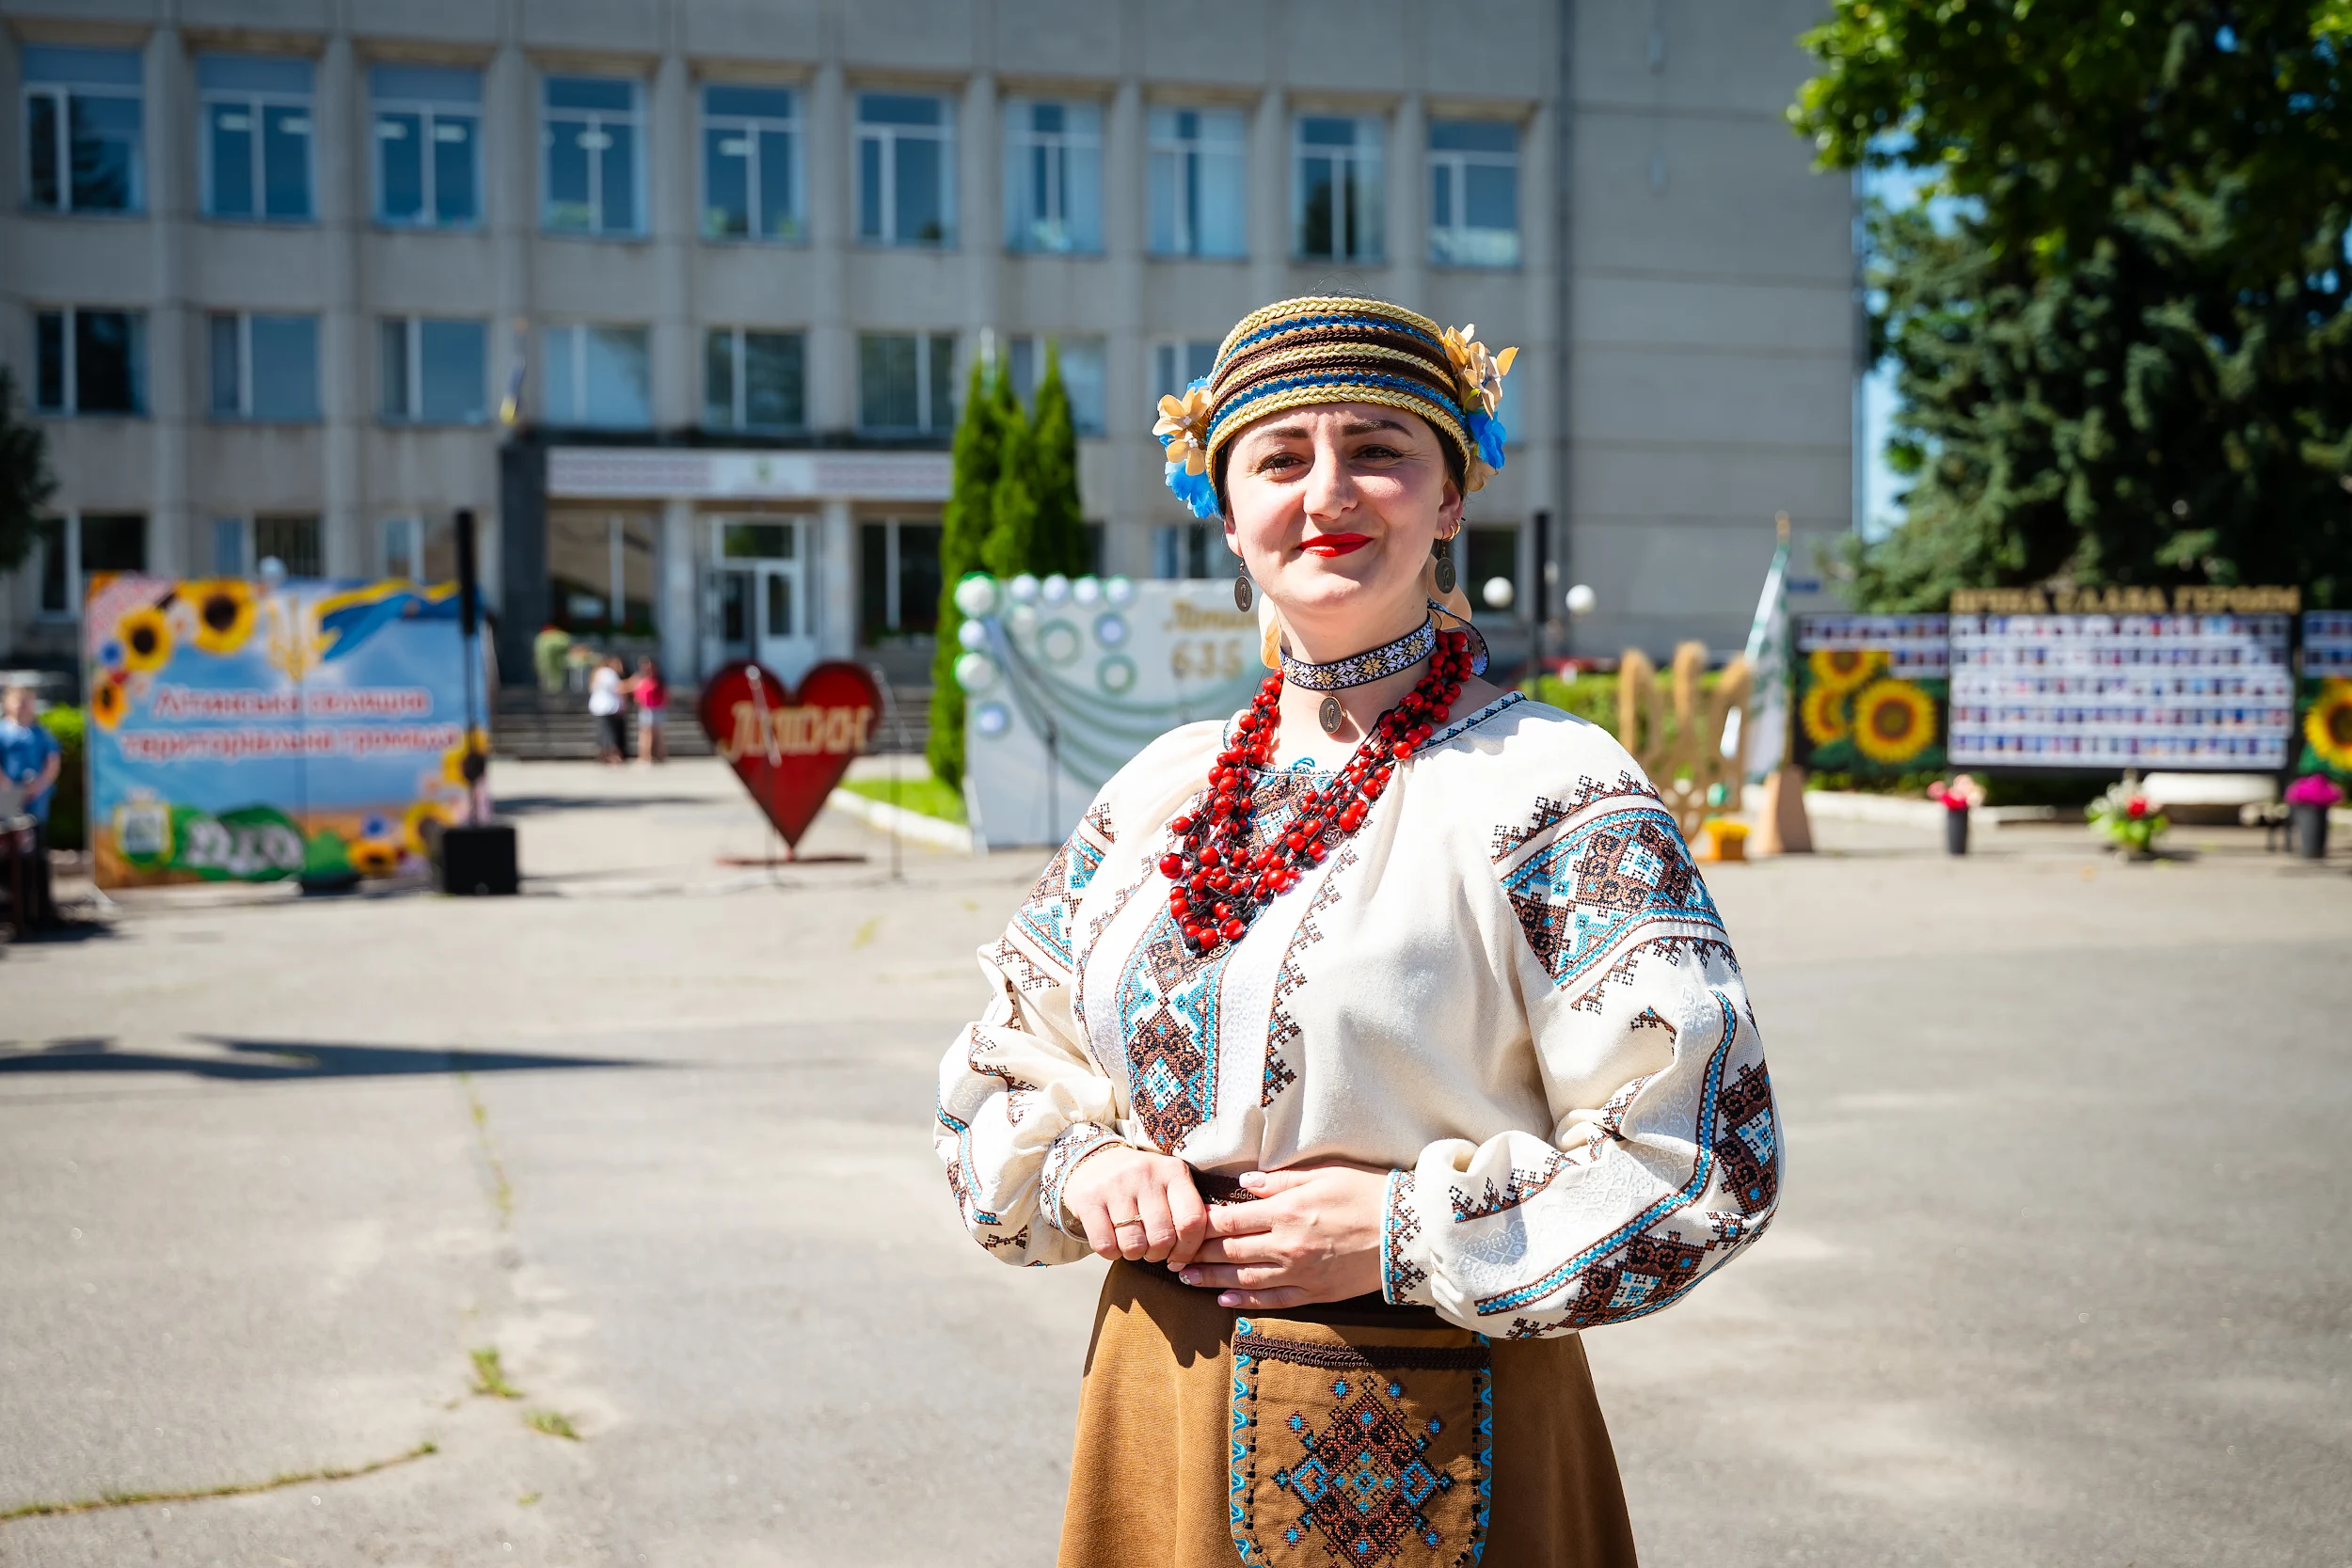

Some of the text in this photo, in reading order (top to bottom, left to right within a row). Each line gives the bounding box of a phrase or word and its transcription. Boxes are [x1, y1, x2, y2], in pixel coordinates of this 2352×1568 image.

[2054, 585, 2166, 613] СЛАВА
[2174, 584, 2300, 614] ГЕРОЯМ
[310, 689, 430, 718] селищна
[122, 726, 459, 761] територіальна громада
